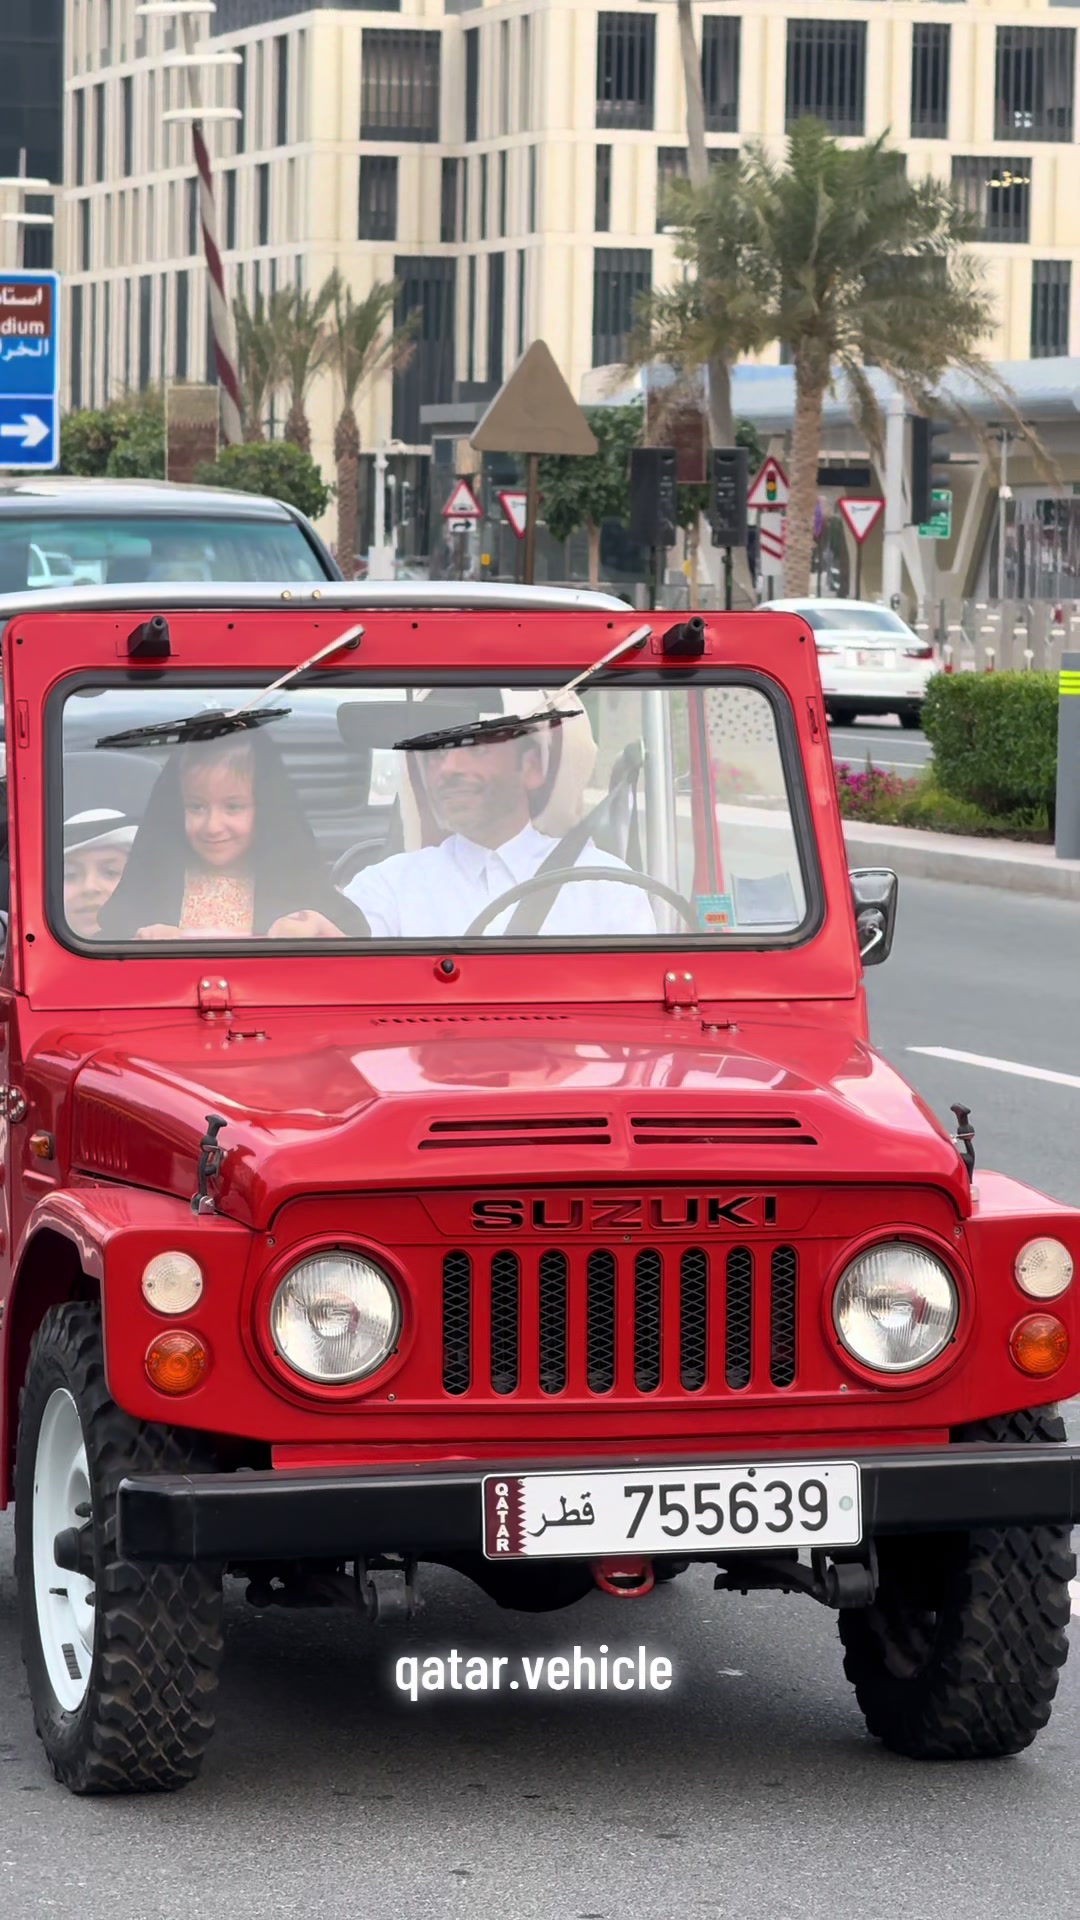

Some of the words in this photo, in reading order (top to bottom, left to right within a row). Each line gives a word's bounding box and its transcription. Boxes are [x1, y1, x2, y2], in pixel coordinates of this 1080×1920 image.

[0, 286, 43, 306] استا
[471, 1194, 777, 1231] SUZUKI
[494, 1482, 511, 1552] QATAR
[526, 1491, 595, 1537] قطر
[623, 1478, 828, 1539] 755639
